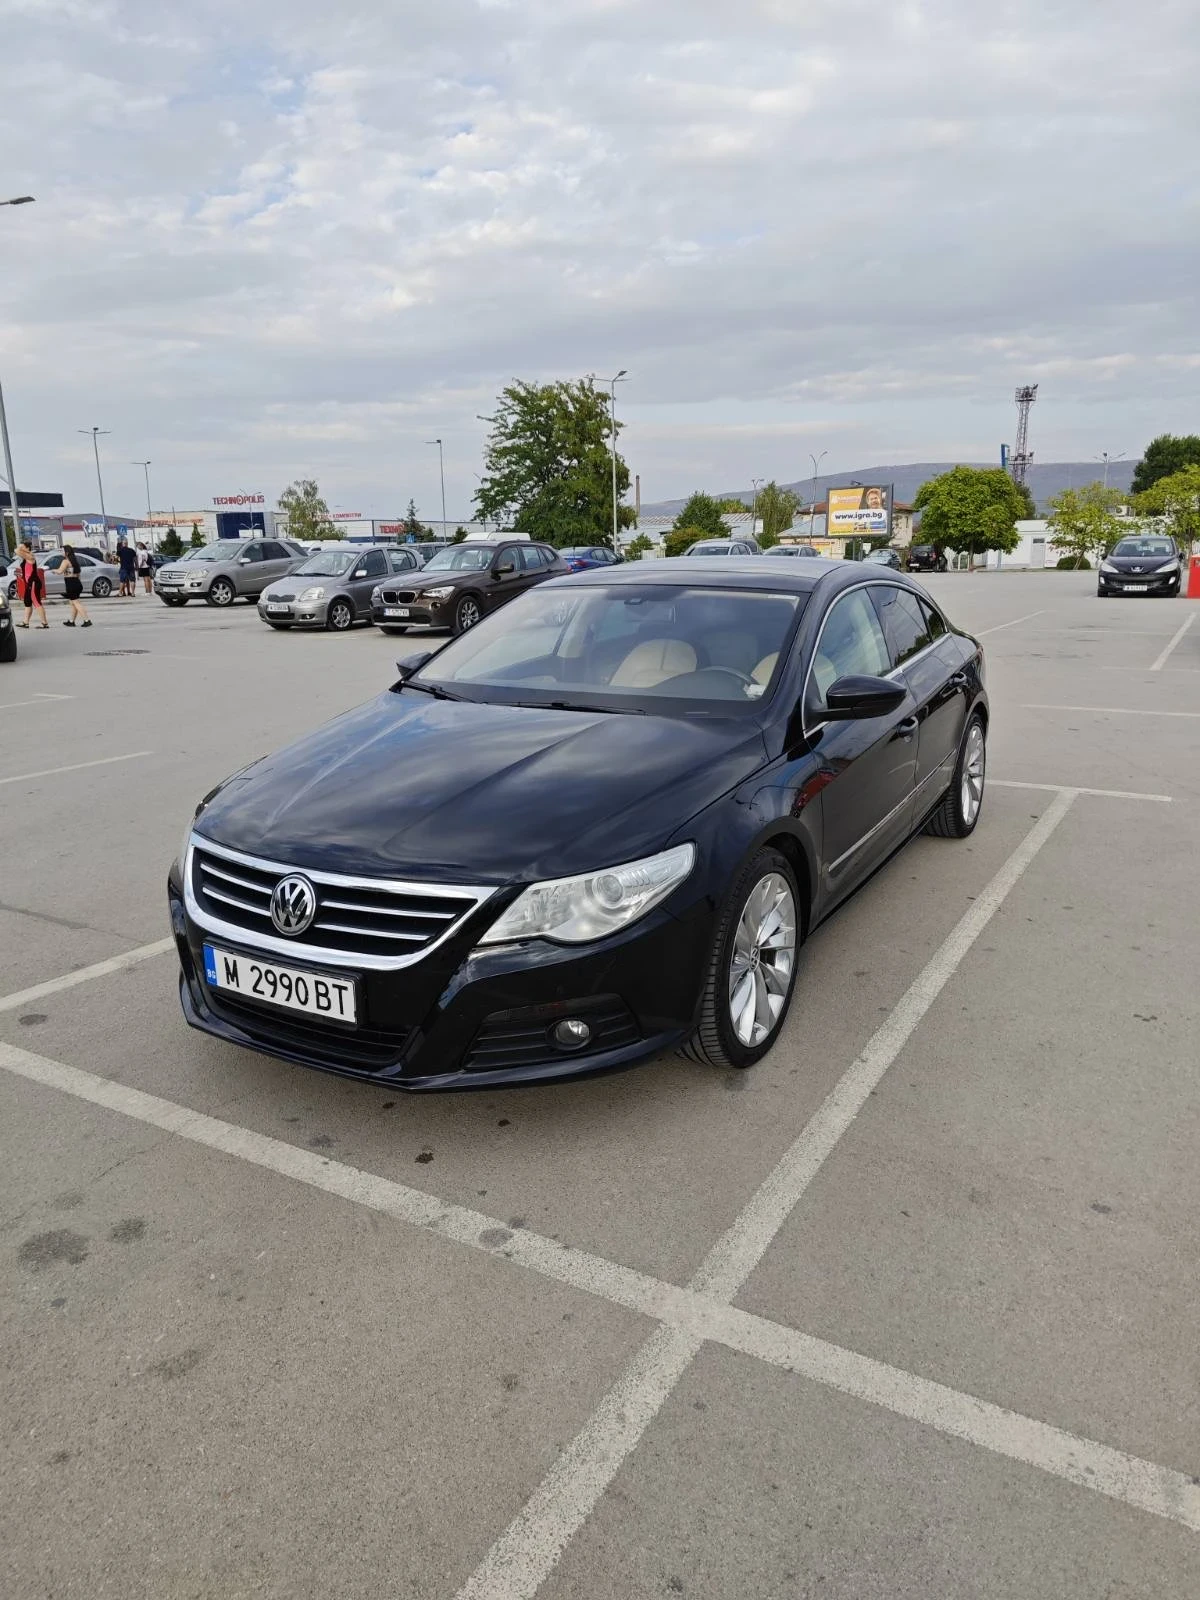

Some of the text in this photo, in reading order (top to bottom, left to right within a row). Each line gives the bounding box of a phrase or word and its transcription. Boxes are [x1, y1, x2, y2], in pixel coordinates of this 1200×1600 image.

[212, 494, 265, 505] TECHNOPOLIS
[835, 511, 883, 520] www.igra.bg
[224, 956, 240, 988] M
